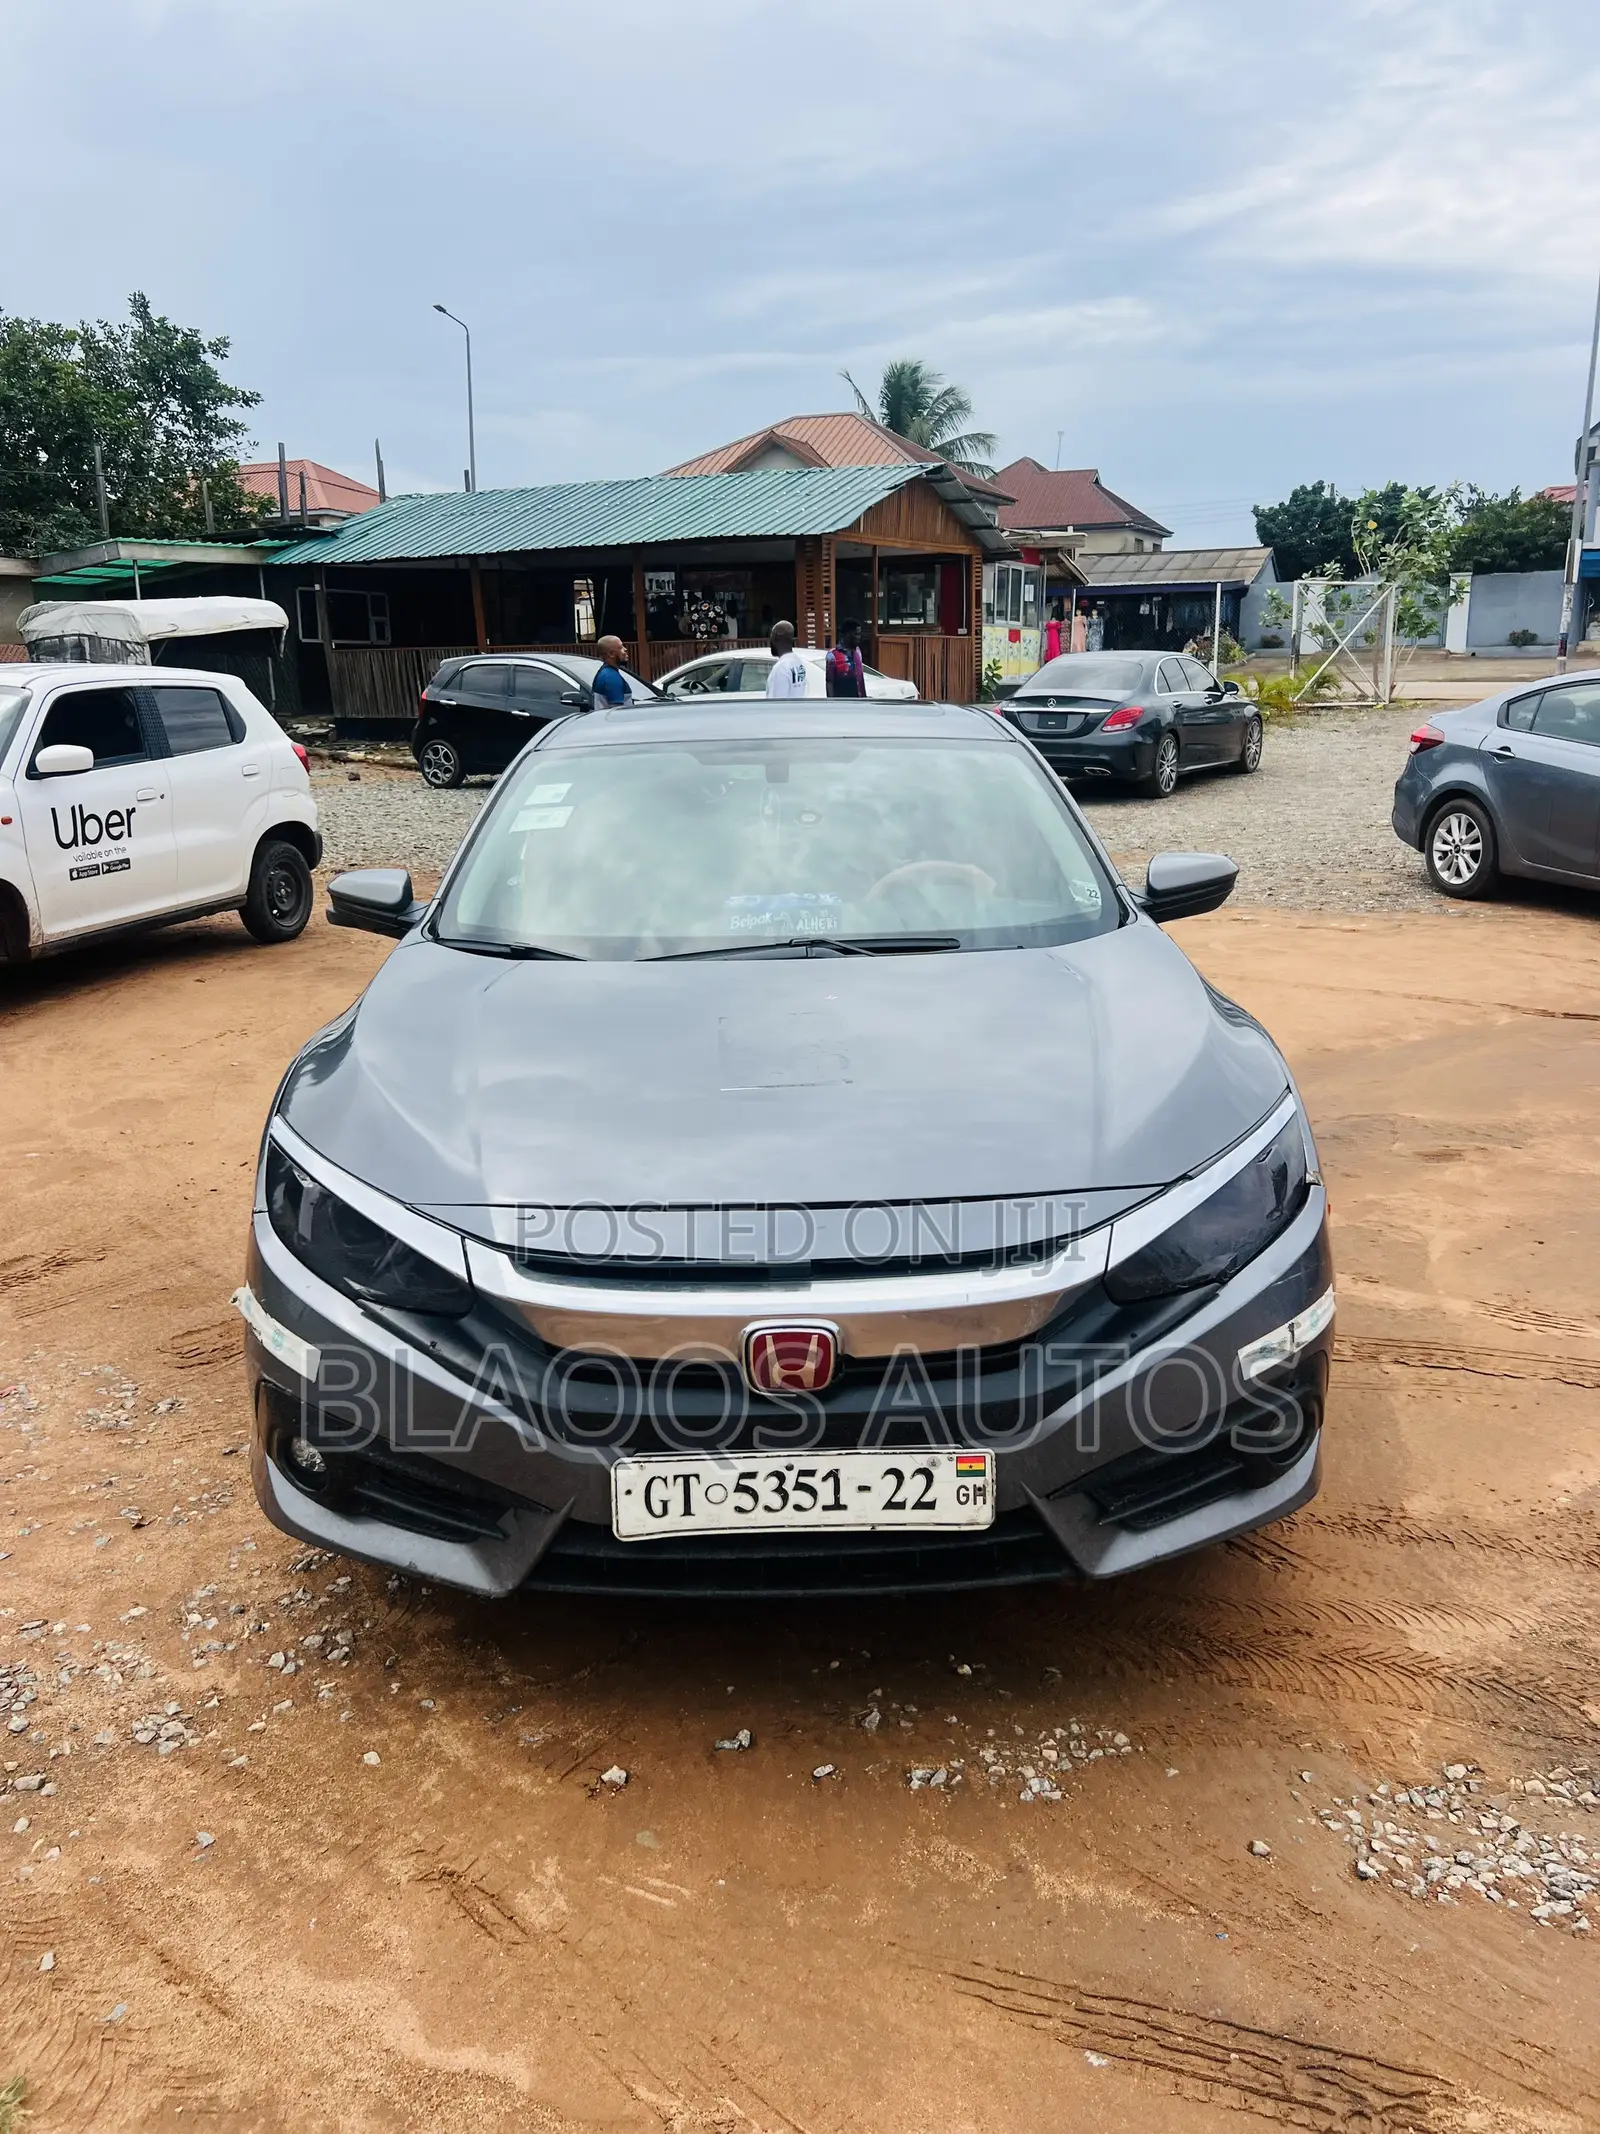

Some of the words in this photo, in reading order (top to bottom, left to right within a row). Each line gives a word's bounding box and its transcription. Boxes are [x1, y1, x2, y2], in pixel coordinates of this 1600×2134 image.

[50, 804, 136, 850] Uber
[114, 846, 127, 855] the
[79, 869, 88, 878] App
[1087, 888, 1100, 899] 22
[643, 1473, 701, 1519] GT
[955, 1484, 988, 1507] GH
